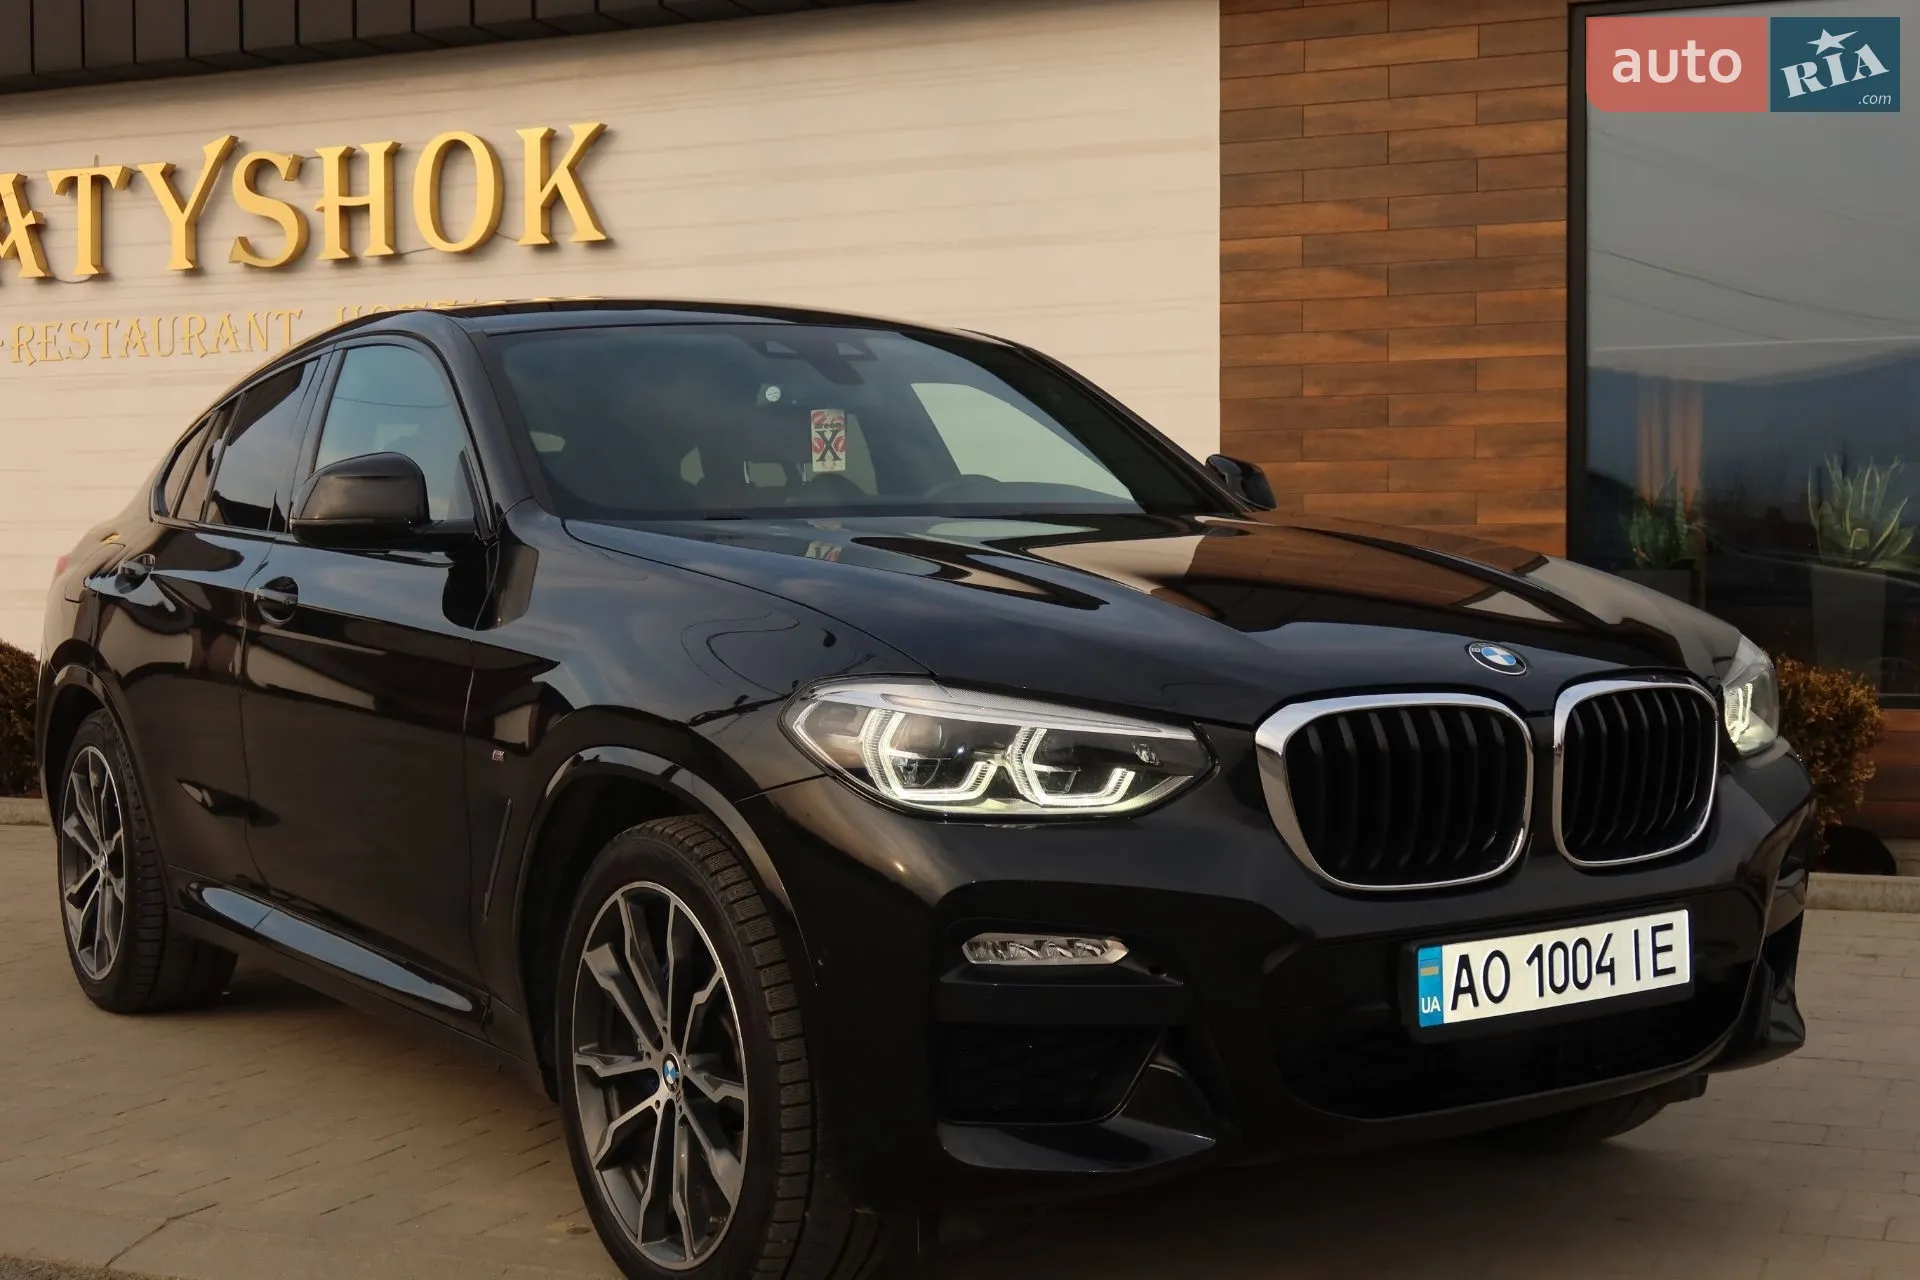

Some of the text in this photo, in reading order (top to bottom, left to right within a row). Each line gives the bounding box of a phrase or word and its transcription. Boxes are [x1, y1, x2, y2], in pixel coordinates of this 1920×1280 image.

[11, 310, 303, 366] RESTAURANT
[1450, 922, 1676, 1011] AO 1004 IE
[1421, 996, 1441, 1014] UA
